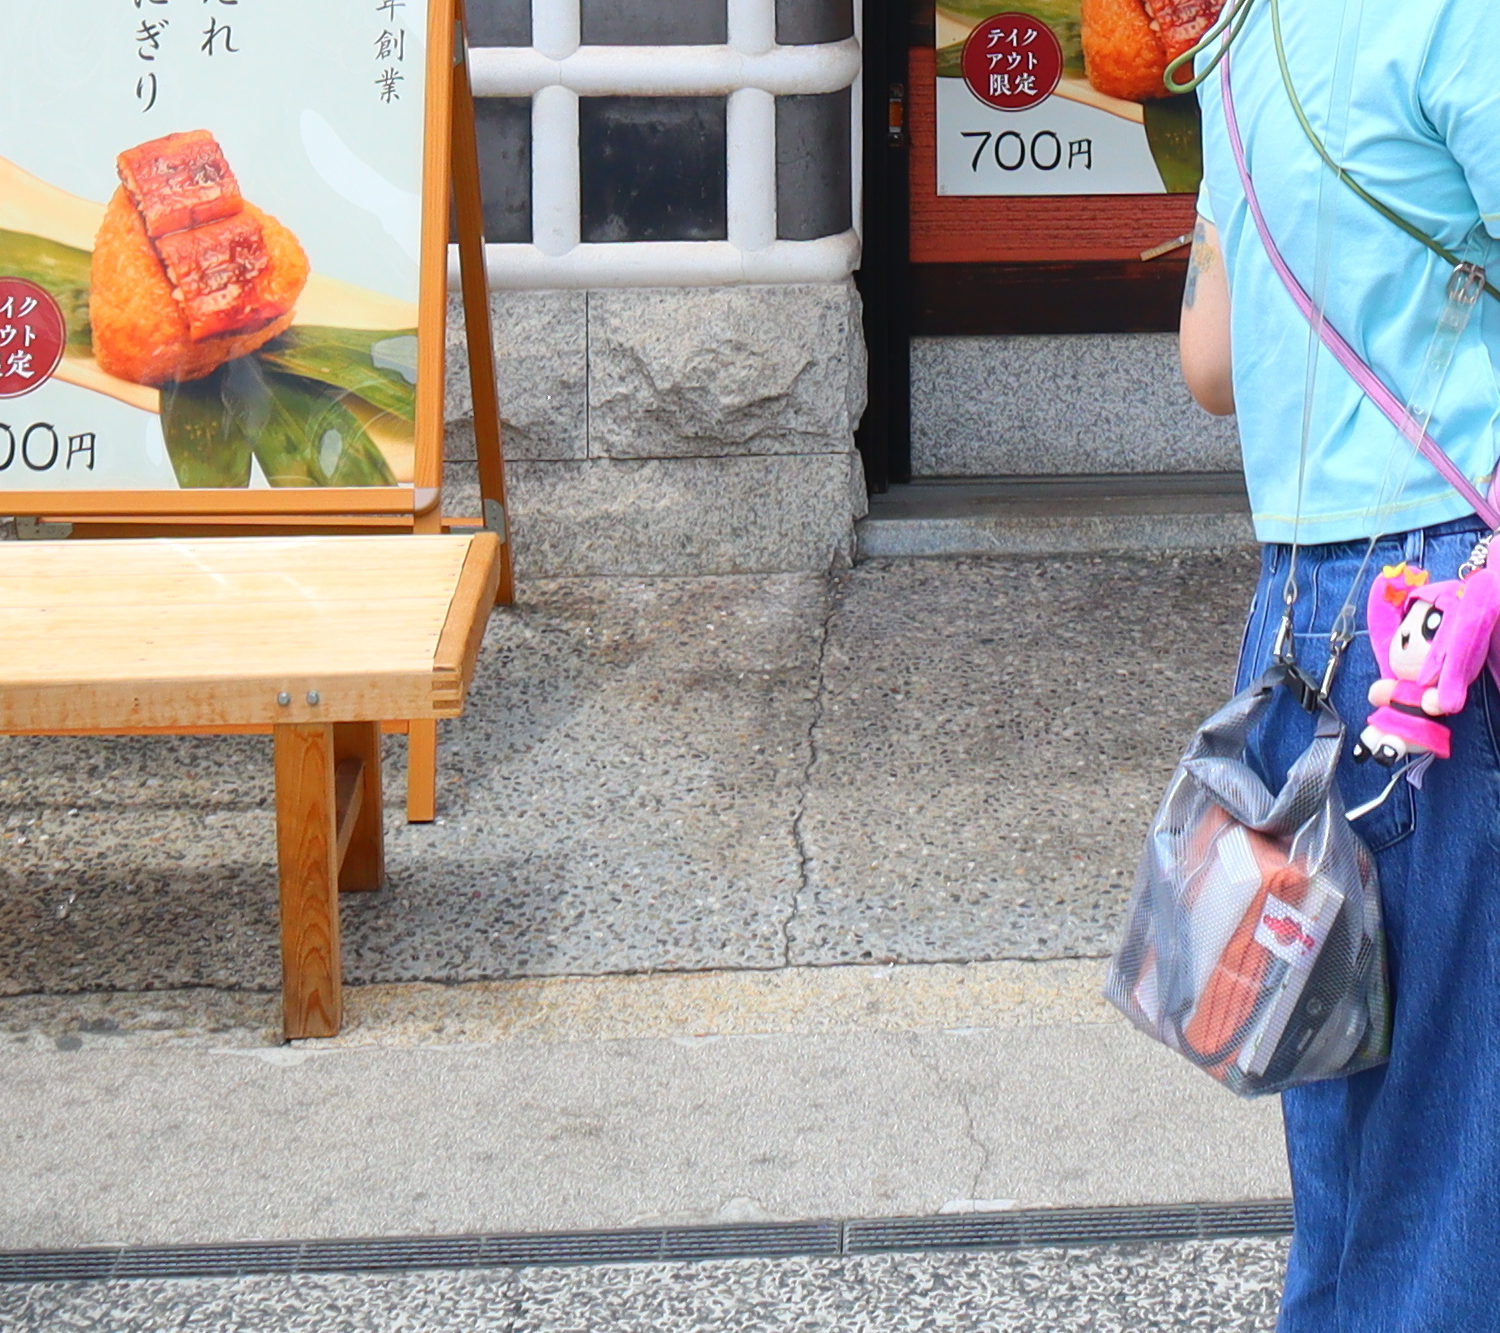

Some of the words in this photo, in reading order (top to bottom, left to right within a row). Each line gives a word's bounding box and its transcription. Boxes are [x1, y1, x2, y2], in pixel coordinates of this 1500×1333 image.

[986, 28, 1038, 49] テイク
[986, 51, 1038, 71] アウト
[989, 72, 1038, 97] 限定
[960, 130, 1092, 172] 700円
